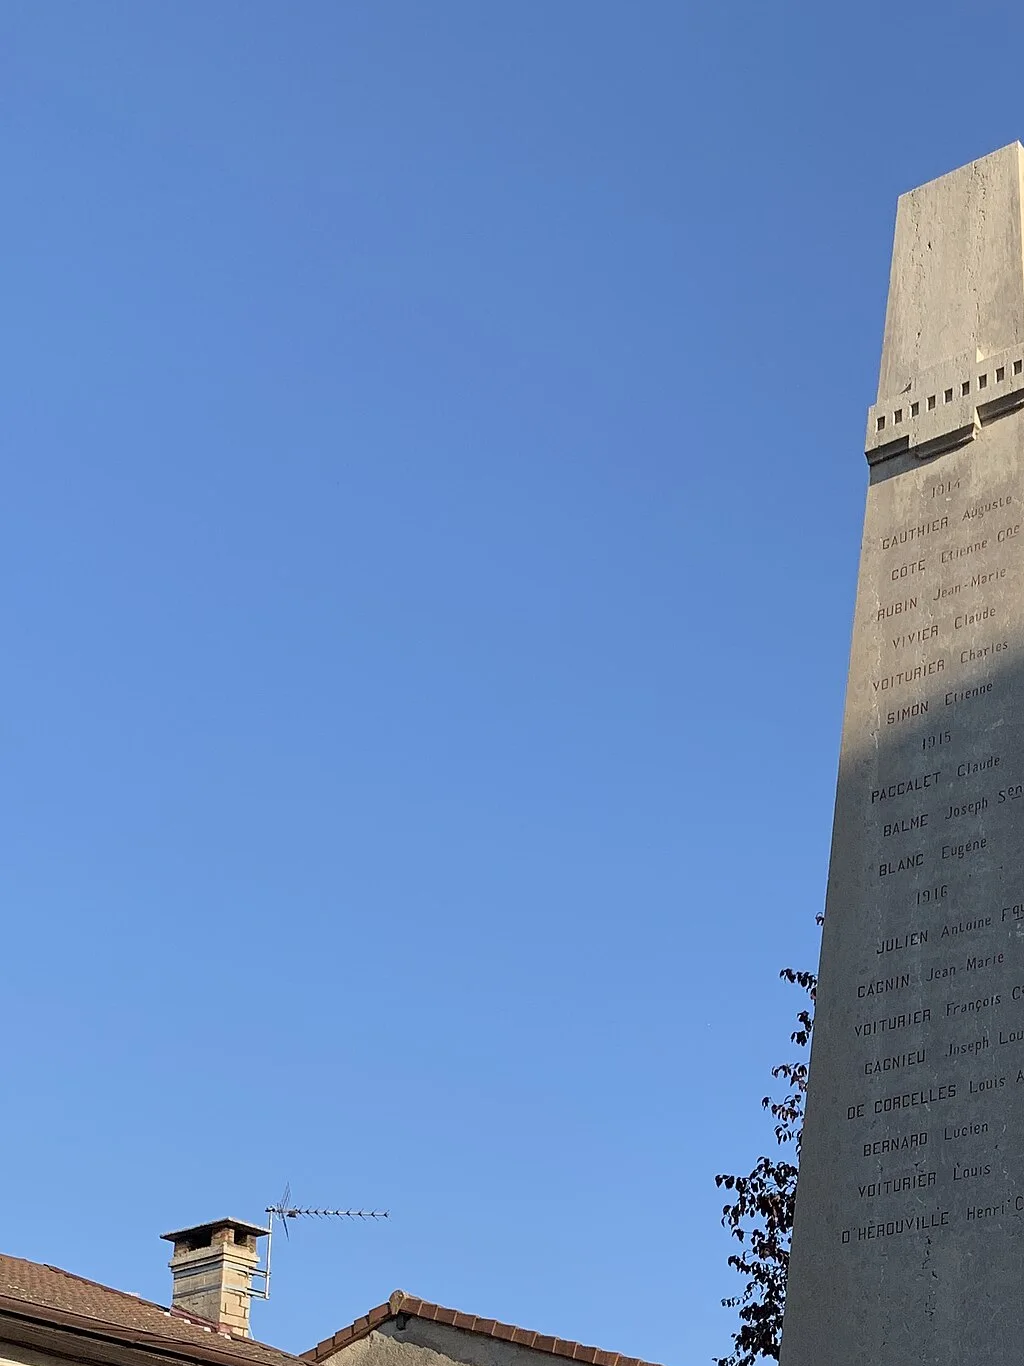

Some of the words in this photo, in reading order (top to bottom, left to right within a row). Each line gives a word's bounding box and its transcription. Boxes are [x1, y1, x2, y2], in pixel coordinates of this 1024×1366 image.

[882, 516, 949, 550] GAUTHIER
[962, 495, 1012, 521] Auguste
[941, 539, 988, 564] Etienne
[877, 597, 918, 621] RUBIN
[893, 625, 939, 649] VIVIER
[954, 607, 996, 629] Claude
[872, 659, 945, 692] VOITURIER
[960, 641, 1008, 664] Charles
[887, 701, 929, 725] SIMON
[945, 682, 993, 706] Etienne
[922, 731, 951, 750] 1915
[871, 772, 941, 804] PACCALET
[957, 756, 1001, 777] Claude
[883, 814, 929, 837] BALME
[945, 797, 988, 820] Joseph
[879, 853, 924, 877] BLANC
[917, 885, 948, 904] 1916
[876, 930, 928, 955] JULIEN
[941, 917, 992, 939] Antoine
[854, 1008, 931, 1037] VOITURIER
[946, 994, 1001, 1017] François
[864, 1050, 926, 1076] GAGNIEU
[945, 1036, 989, 1057] Joseph
[847, 1103, 865, 1120] DE
[874, 1084, 957, 1114] CORCELLES
[969, 1075, 1006, 1094] Louis
[863, 1132, 928, 1157] BERNARD
[944, 1122, 989, 1141] Lucien
[858, 1171, 937, 1198] VOITURIER
[953, 1164, 991, 1181] Louis
[966, 1204, 1005, 1221] Henri
